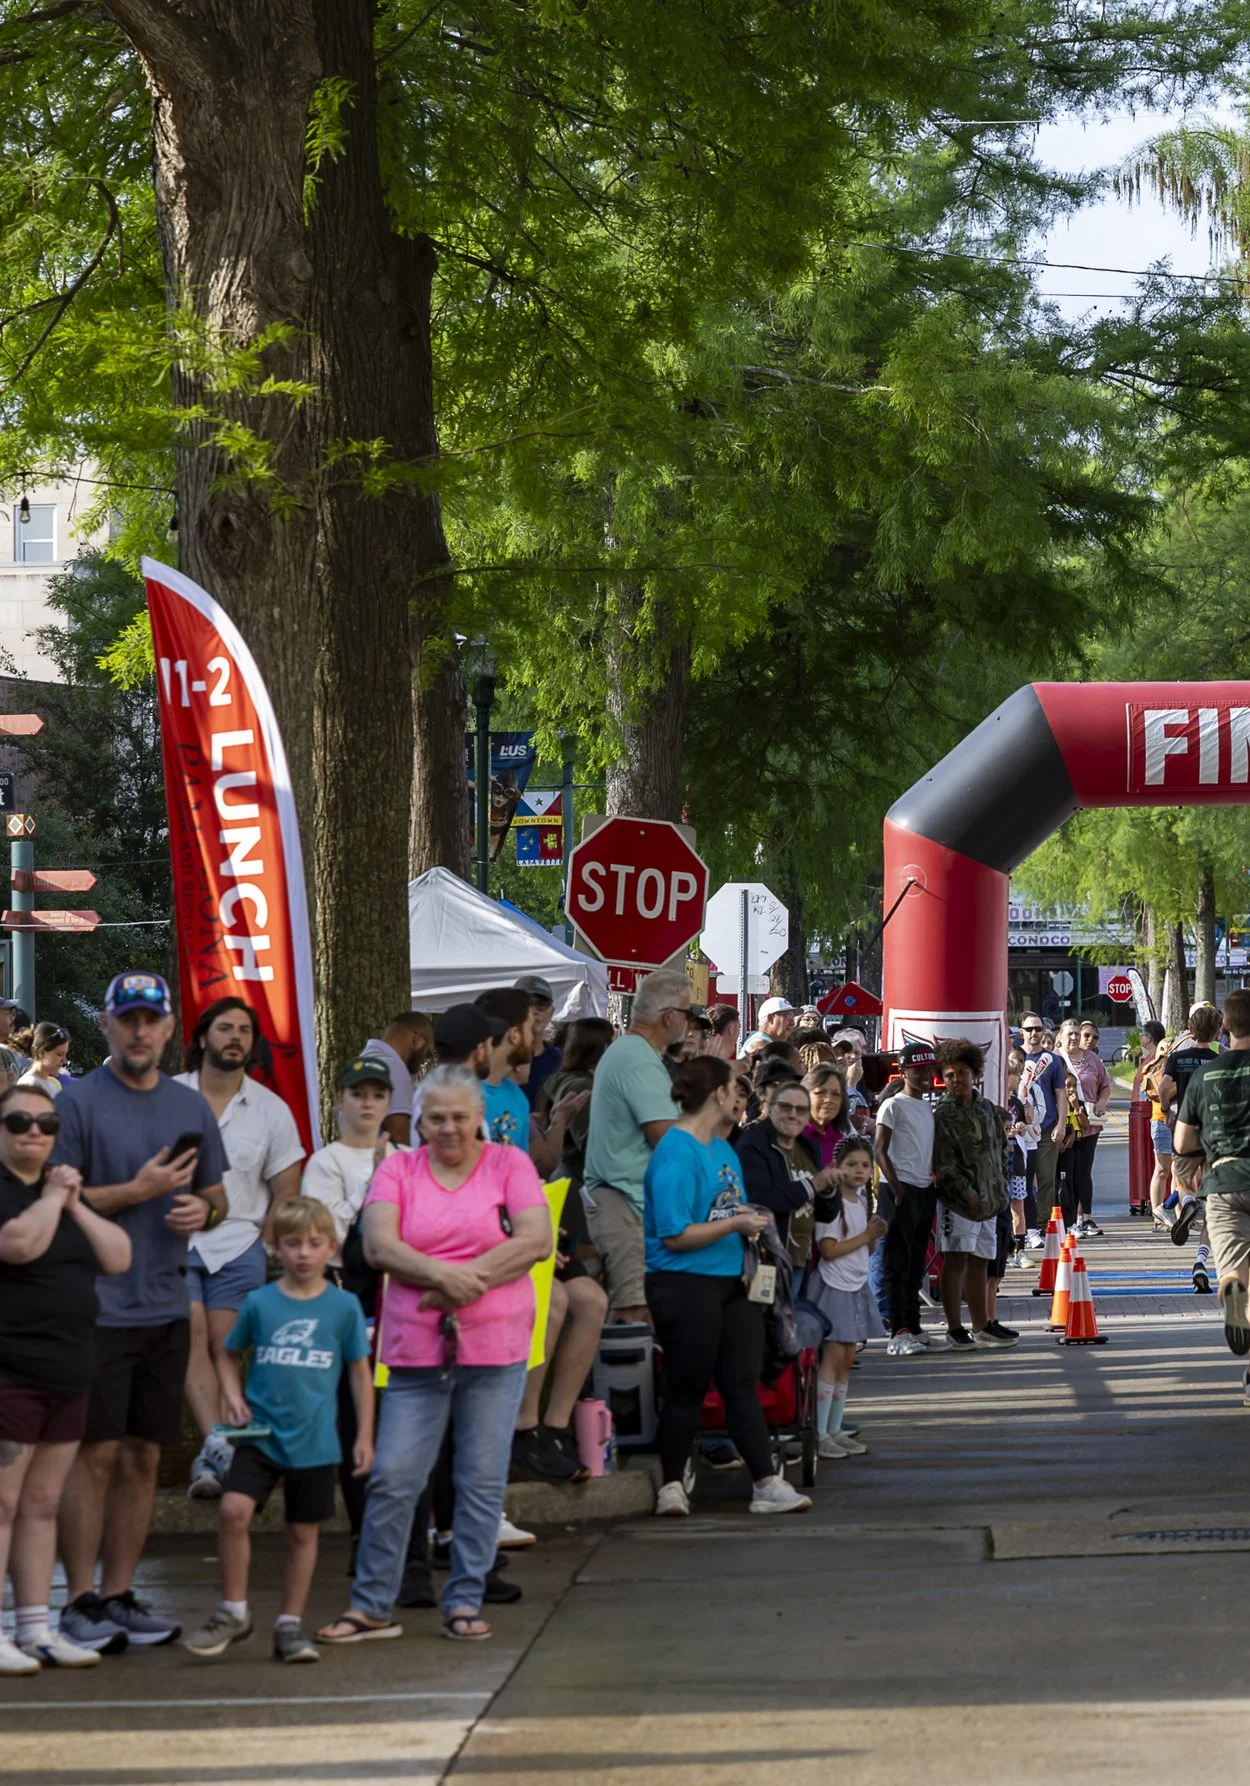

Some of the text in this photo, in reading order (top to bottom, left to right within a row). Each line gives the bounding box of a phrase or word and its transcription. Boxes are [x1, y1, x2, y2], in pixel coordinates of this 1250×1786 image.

[211, 729, 274, 982] LUNCH
[577, 861, 698, 922] STOP
[609, 969, 626, 988] LL
[1109, 983, 1132, 994] STOP
[256, 1346, 334, 1369] EAGLES
